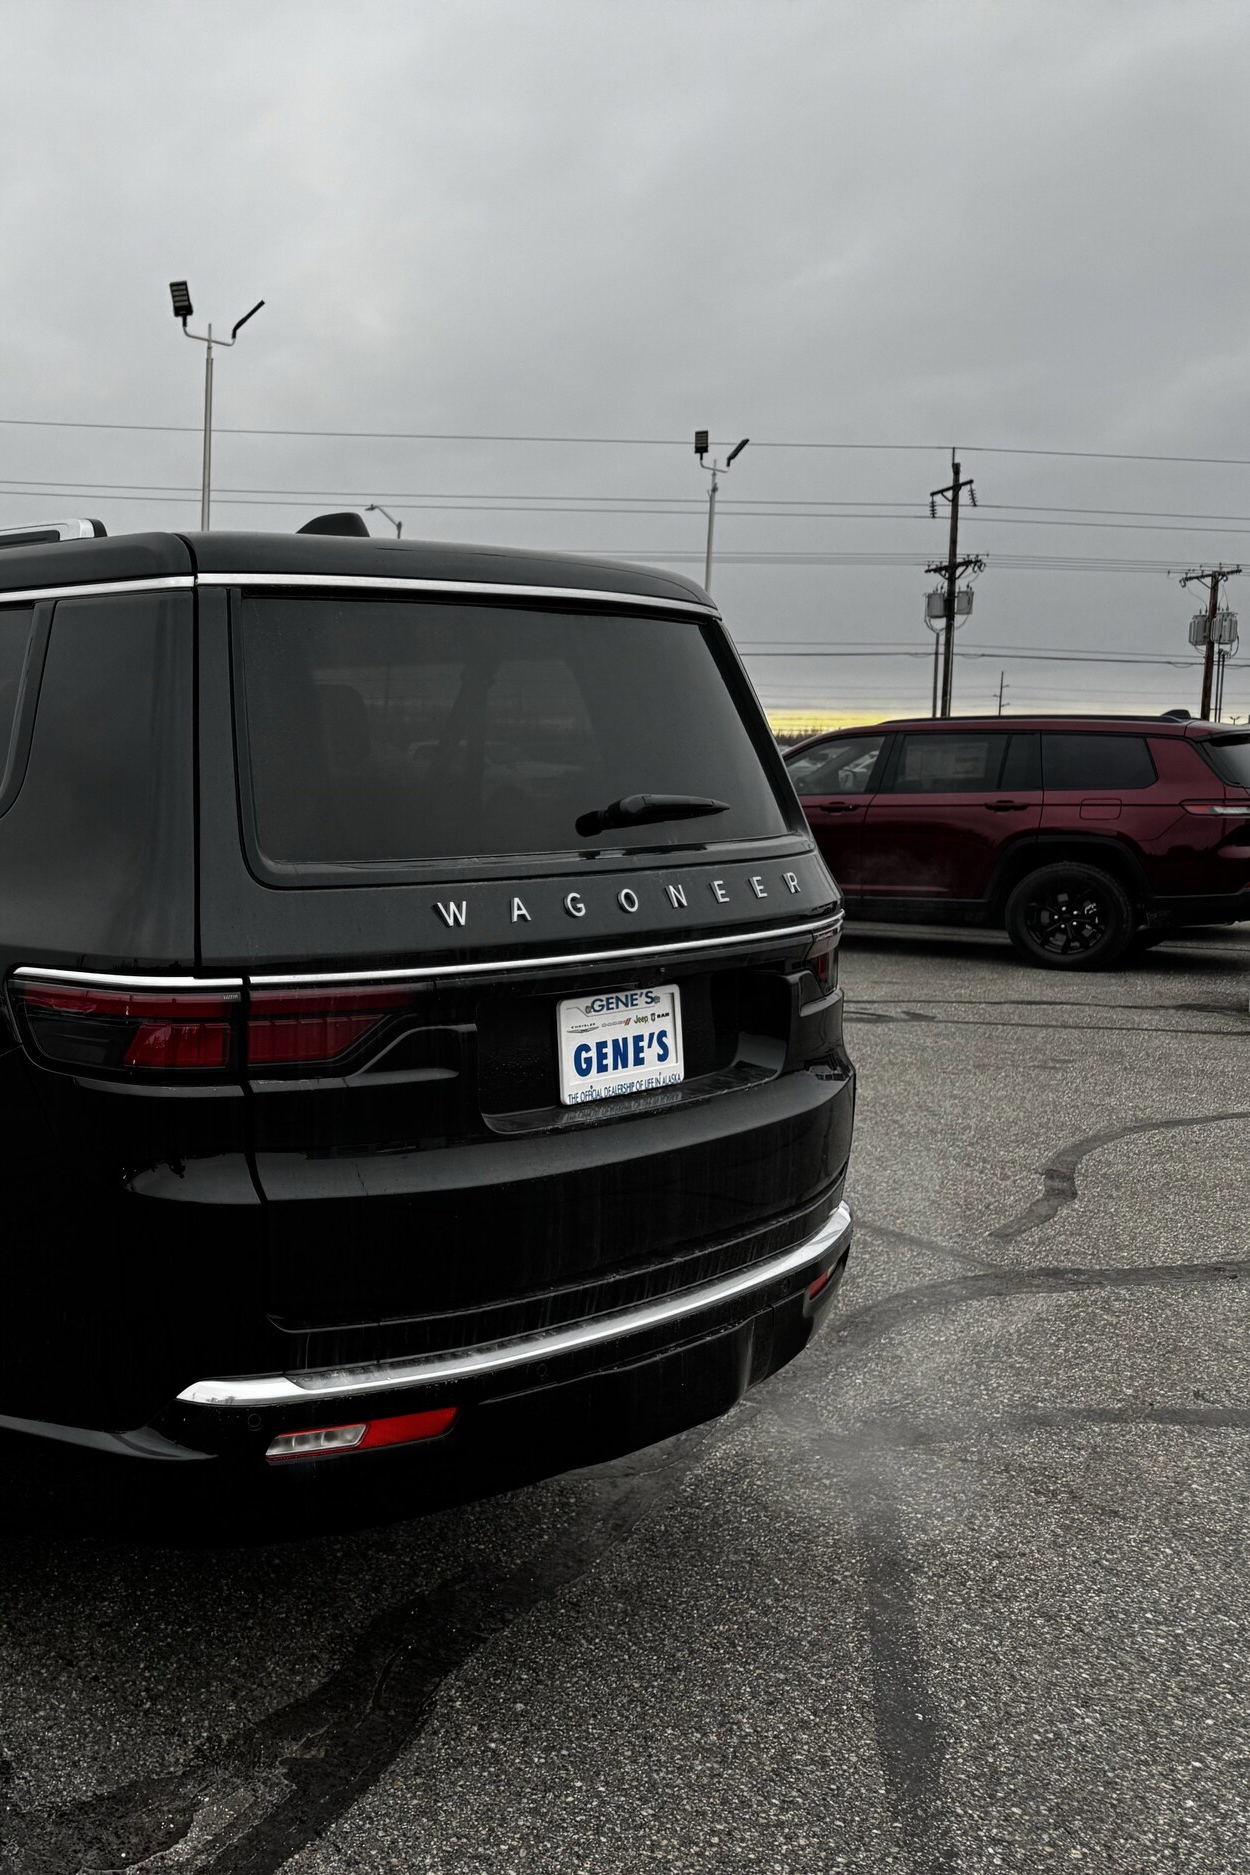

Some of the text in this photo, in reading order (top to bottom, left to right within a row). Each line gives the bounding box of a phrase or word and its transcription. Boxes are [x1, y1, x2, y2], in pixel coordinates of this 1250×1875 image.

[432, 871, 801, 928] WAGONEER
[591, 990, 655, 1013] GENE'S
[634, 1014, 649, 1024] Jeep
[574, 1030, 670, 1077] GENE'S
[568, 1072, 682, 1104] THE OFFICIAL DEALERSHIP OF LIFE IN ALASKA
